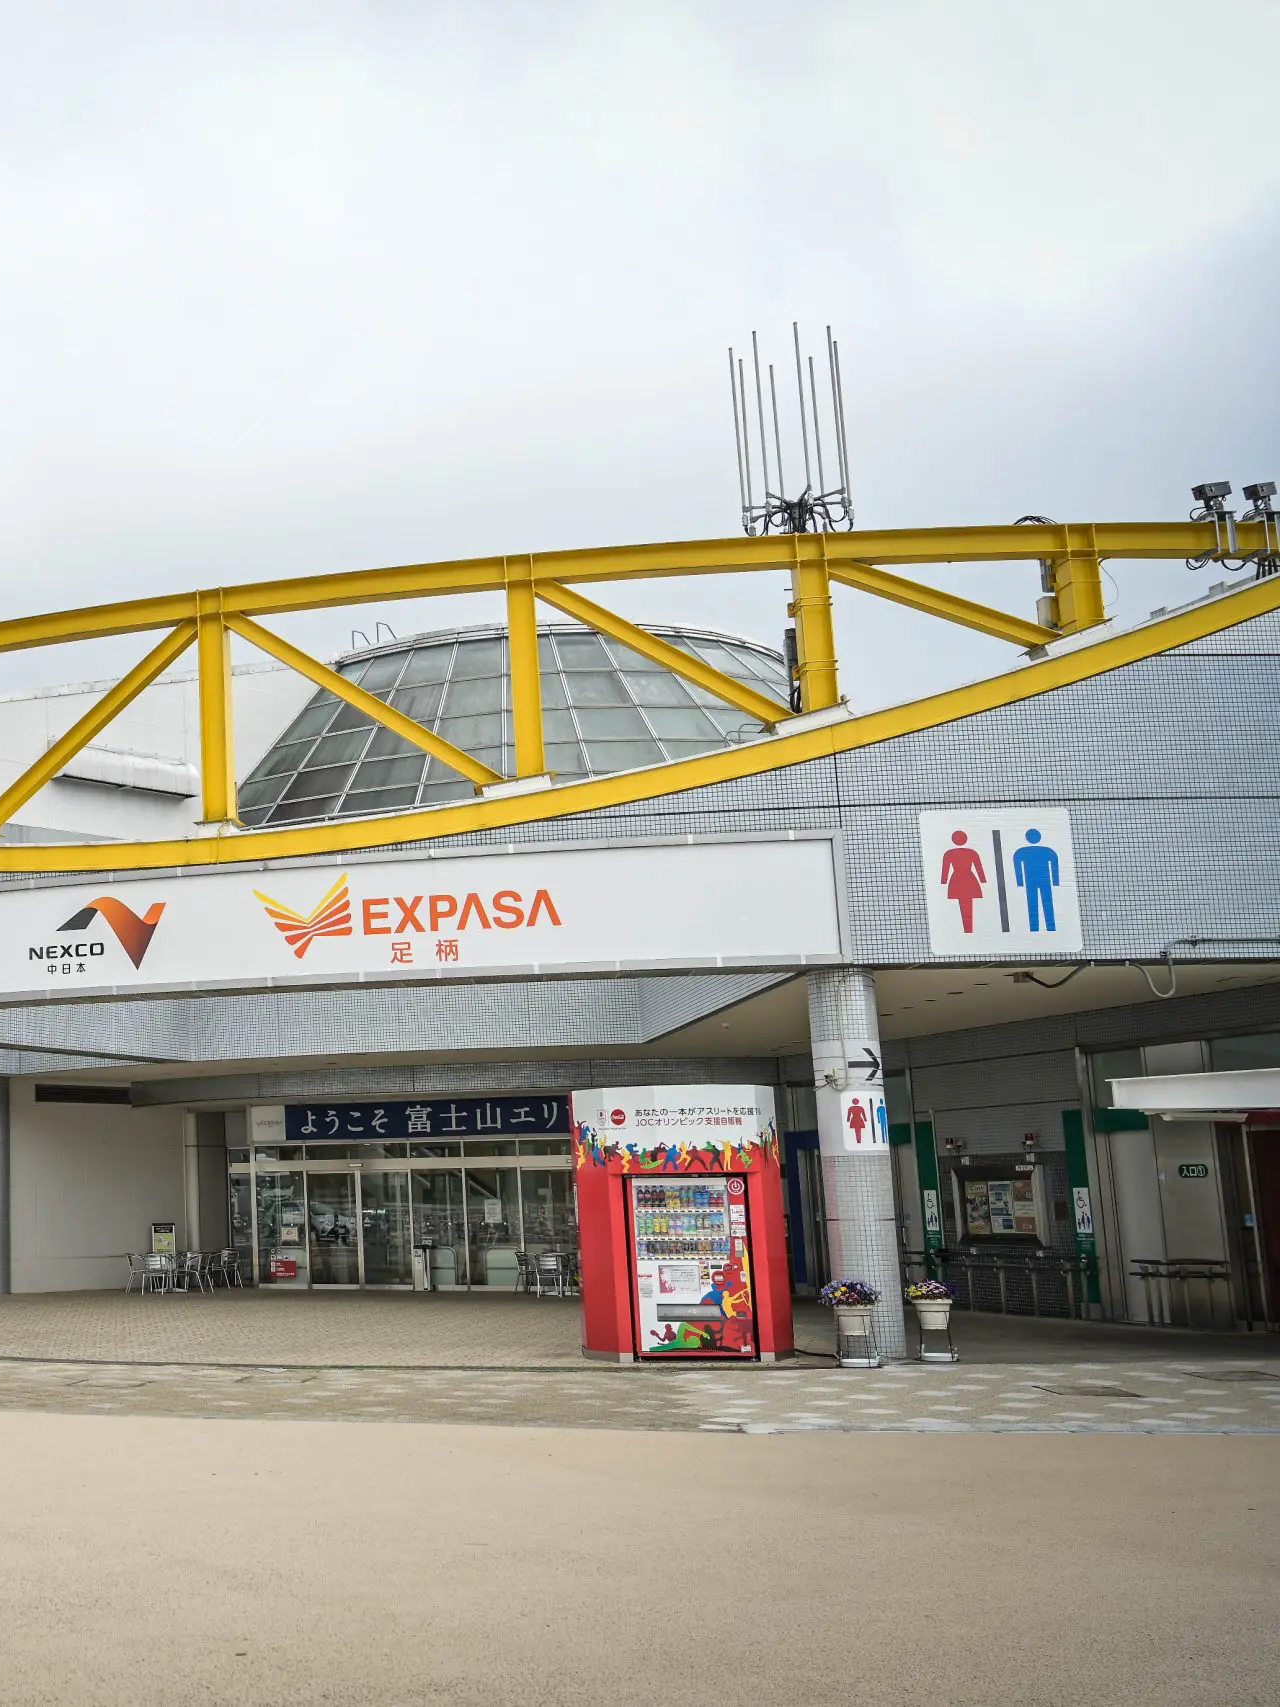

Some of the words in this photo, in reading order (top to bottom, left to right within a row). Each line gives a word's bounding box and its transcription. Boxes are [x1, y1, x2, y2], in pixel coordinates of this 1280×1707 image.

[362, 889, 562, 935] EXPASA
[28, 942, 105, 960] NEXCO
[390, 938, 459, 963] 足柄
[47, 962, 86, 975] 中日本
[405, 1101, 567, 1133] 富士山エリ
